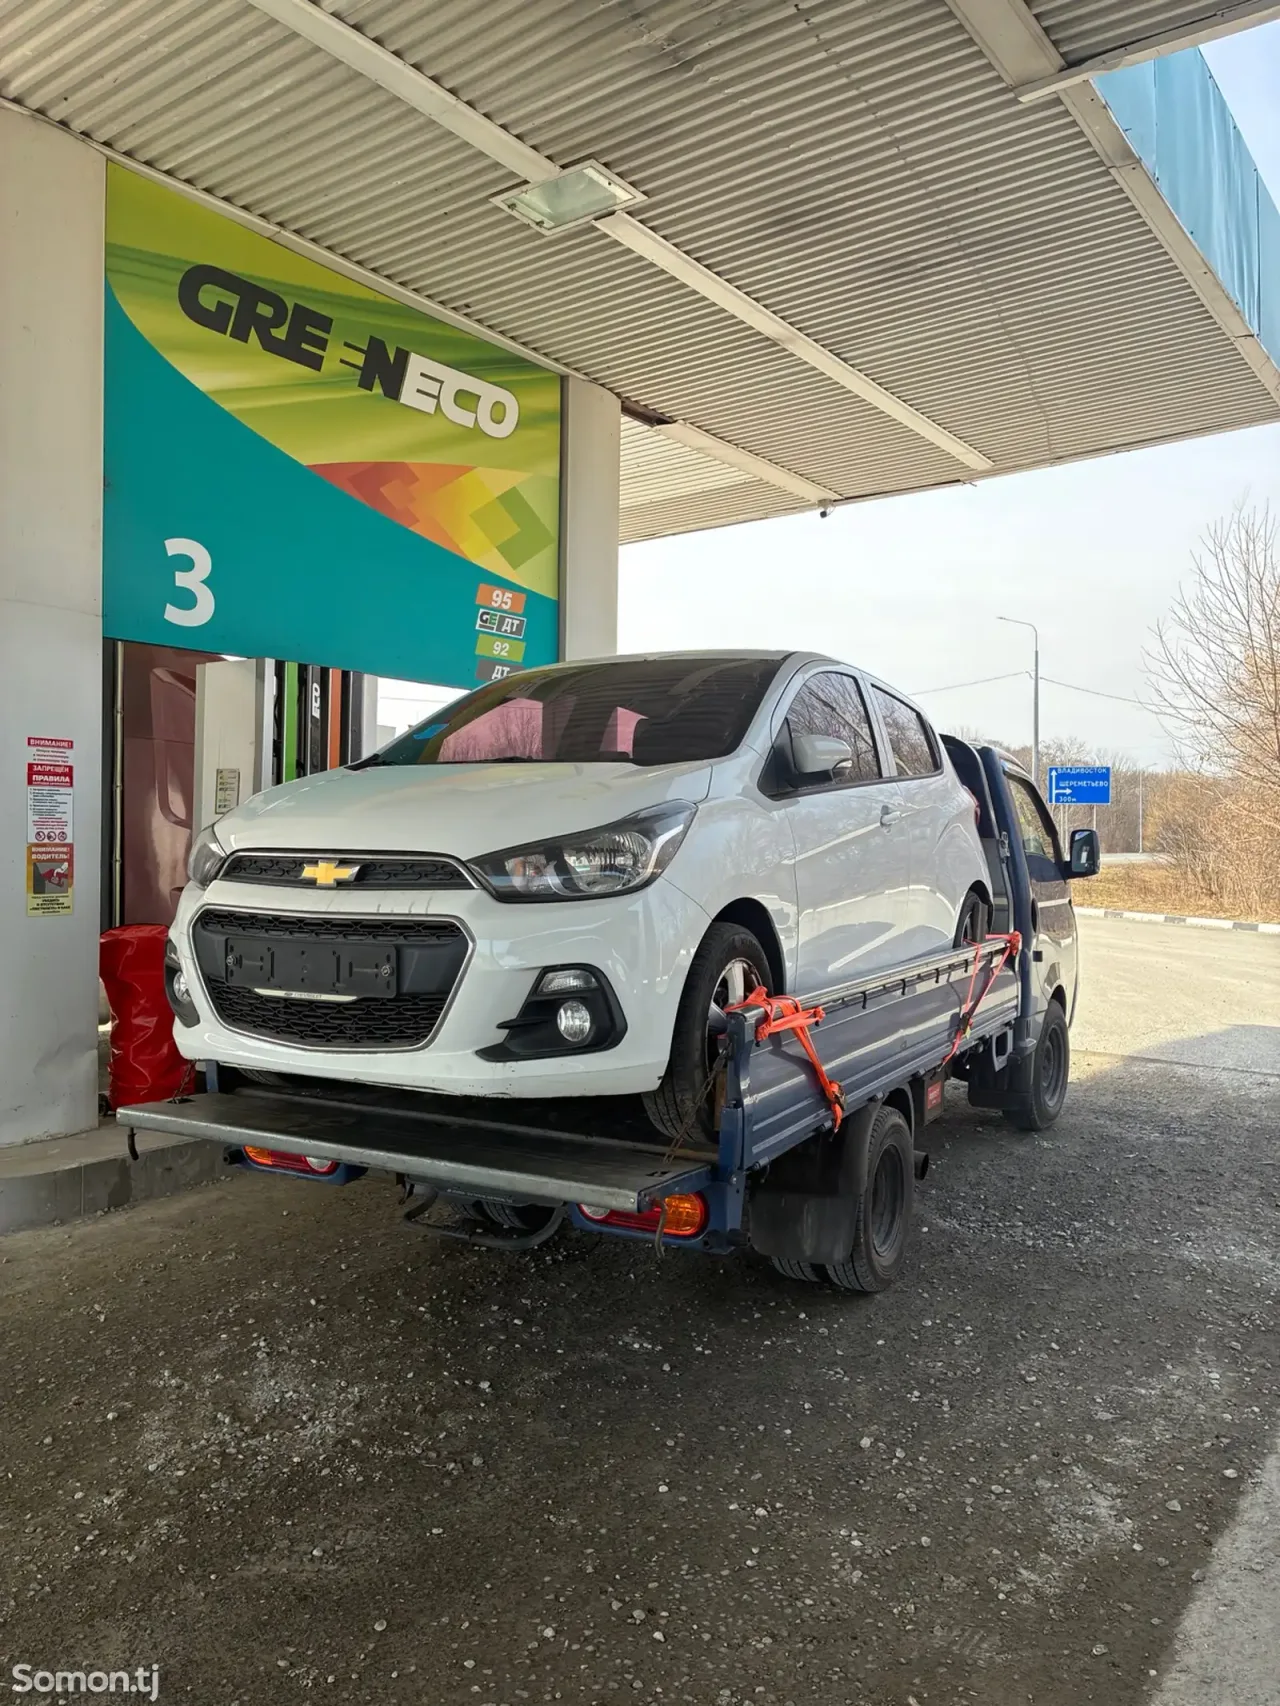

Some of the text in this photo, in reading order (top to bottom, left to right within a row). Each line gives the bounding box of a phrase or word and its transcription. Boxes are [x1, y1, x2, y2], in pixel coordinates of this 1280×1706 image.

[164, 537, 215, 627] 3
[491, 590, 512, 610] 95
[501, 618, 520, 633] ДТ
[492, 641, 510, 656] 92
[491, 665, 510, 680] ДТ
[29, 738, 72, 748] ВНИМАНИЕ!
[32, 774, 71, 783] ПРАВИЛА
